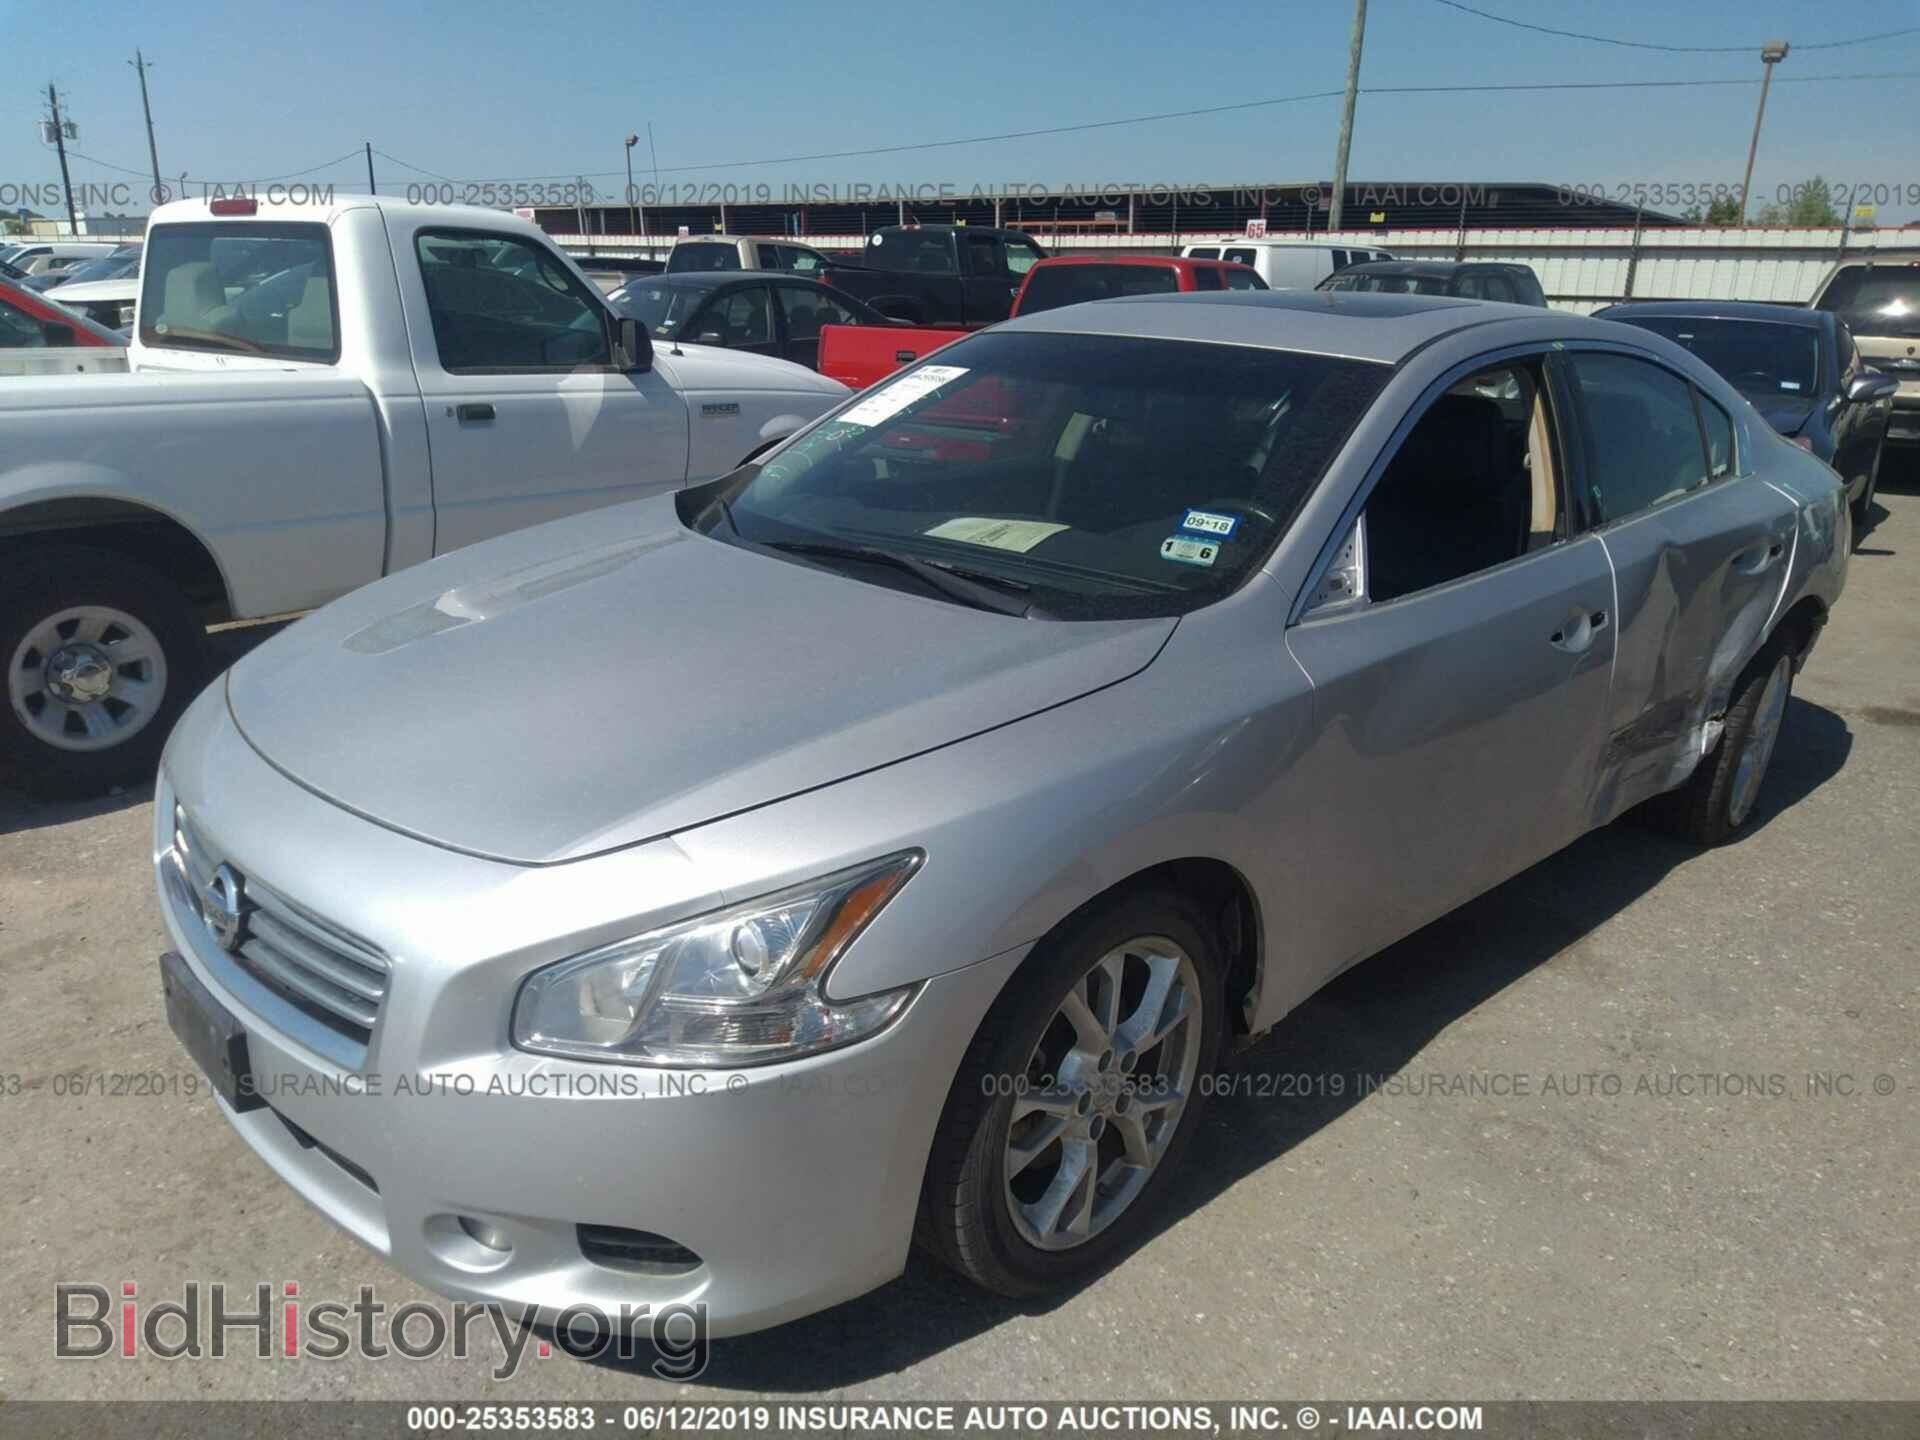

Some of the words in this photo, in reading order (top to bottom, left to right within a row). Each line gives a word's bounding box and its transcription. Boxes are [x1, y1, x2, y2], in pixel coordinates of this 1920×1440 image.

[1247, 223, 1265, 239] 65
[1166, 541, 1173, 552] 1
[1200, 548, 1212, 559] 6
